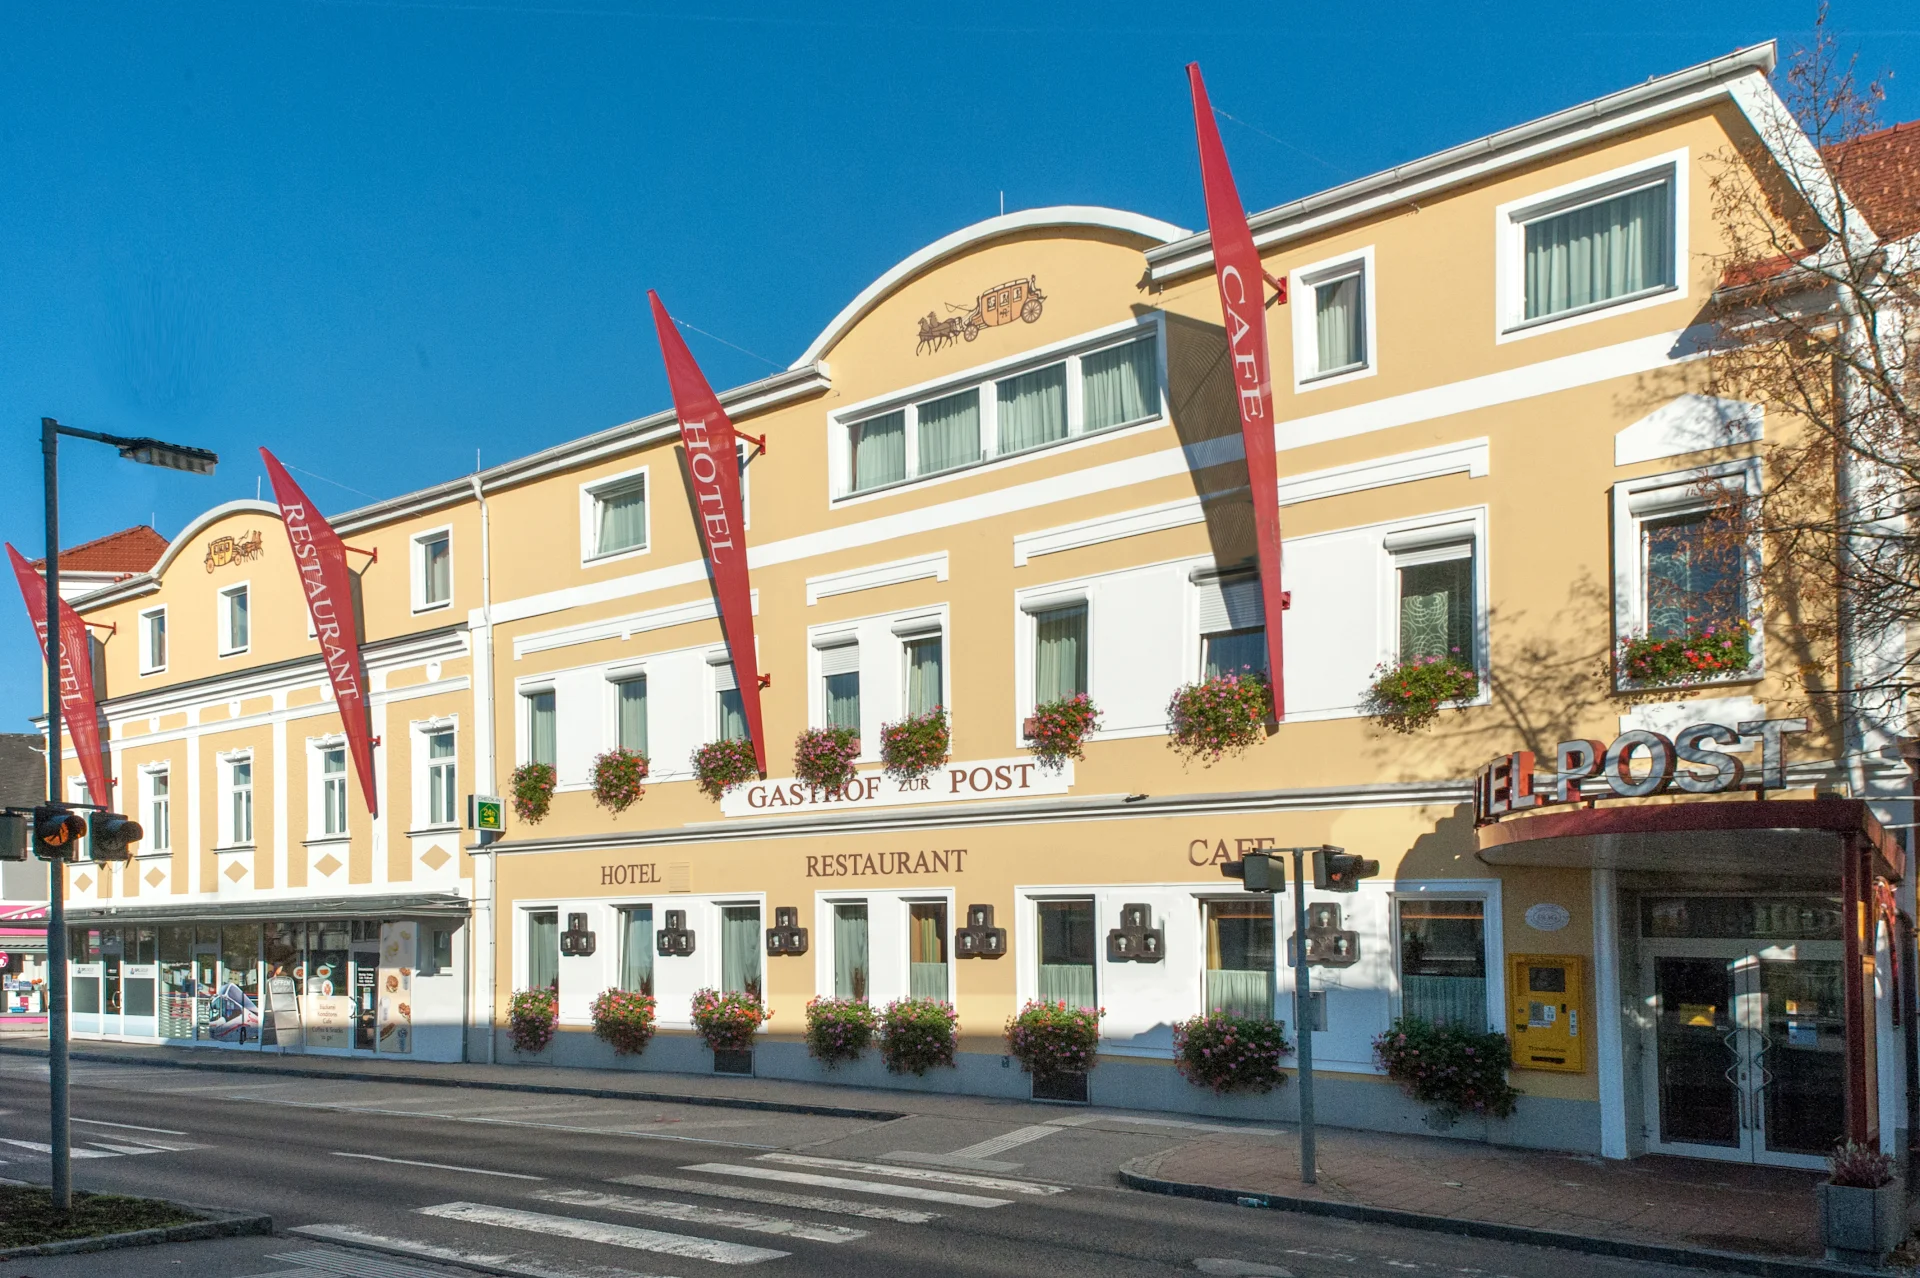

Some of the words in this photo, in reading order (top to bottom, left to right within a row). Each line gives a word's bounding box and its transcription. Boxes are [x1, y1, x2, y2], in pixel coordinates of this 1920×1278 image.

[1221, 265, 1264, 422] CAFE
[682, 418, 734, 565] HOTEL
[281, 501, 359, 700] RESTAURANT
[747, 776, 881, 808] GASTHOF
[898, 777, 931, 792] ZUR
[949, 763, 1036, 793] POST
[1557, 717, 1812, 801] POST
[600, 863, 662, 885] HOTEL
[805, 849, 968, 877] RESTAURANT
